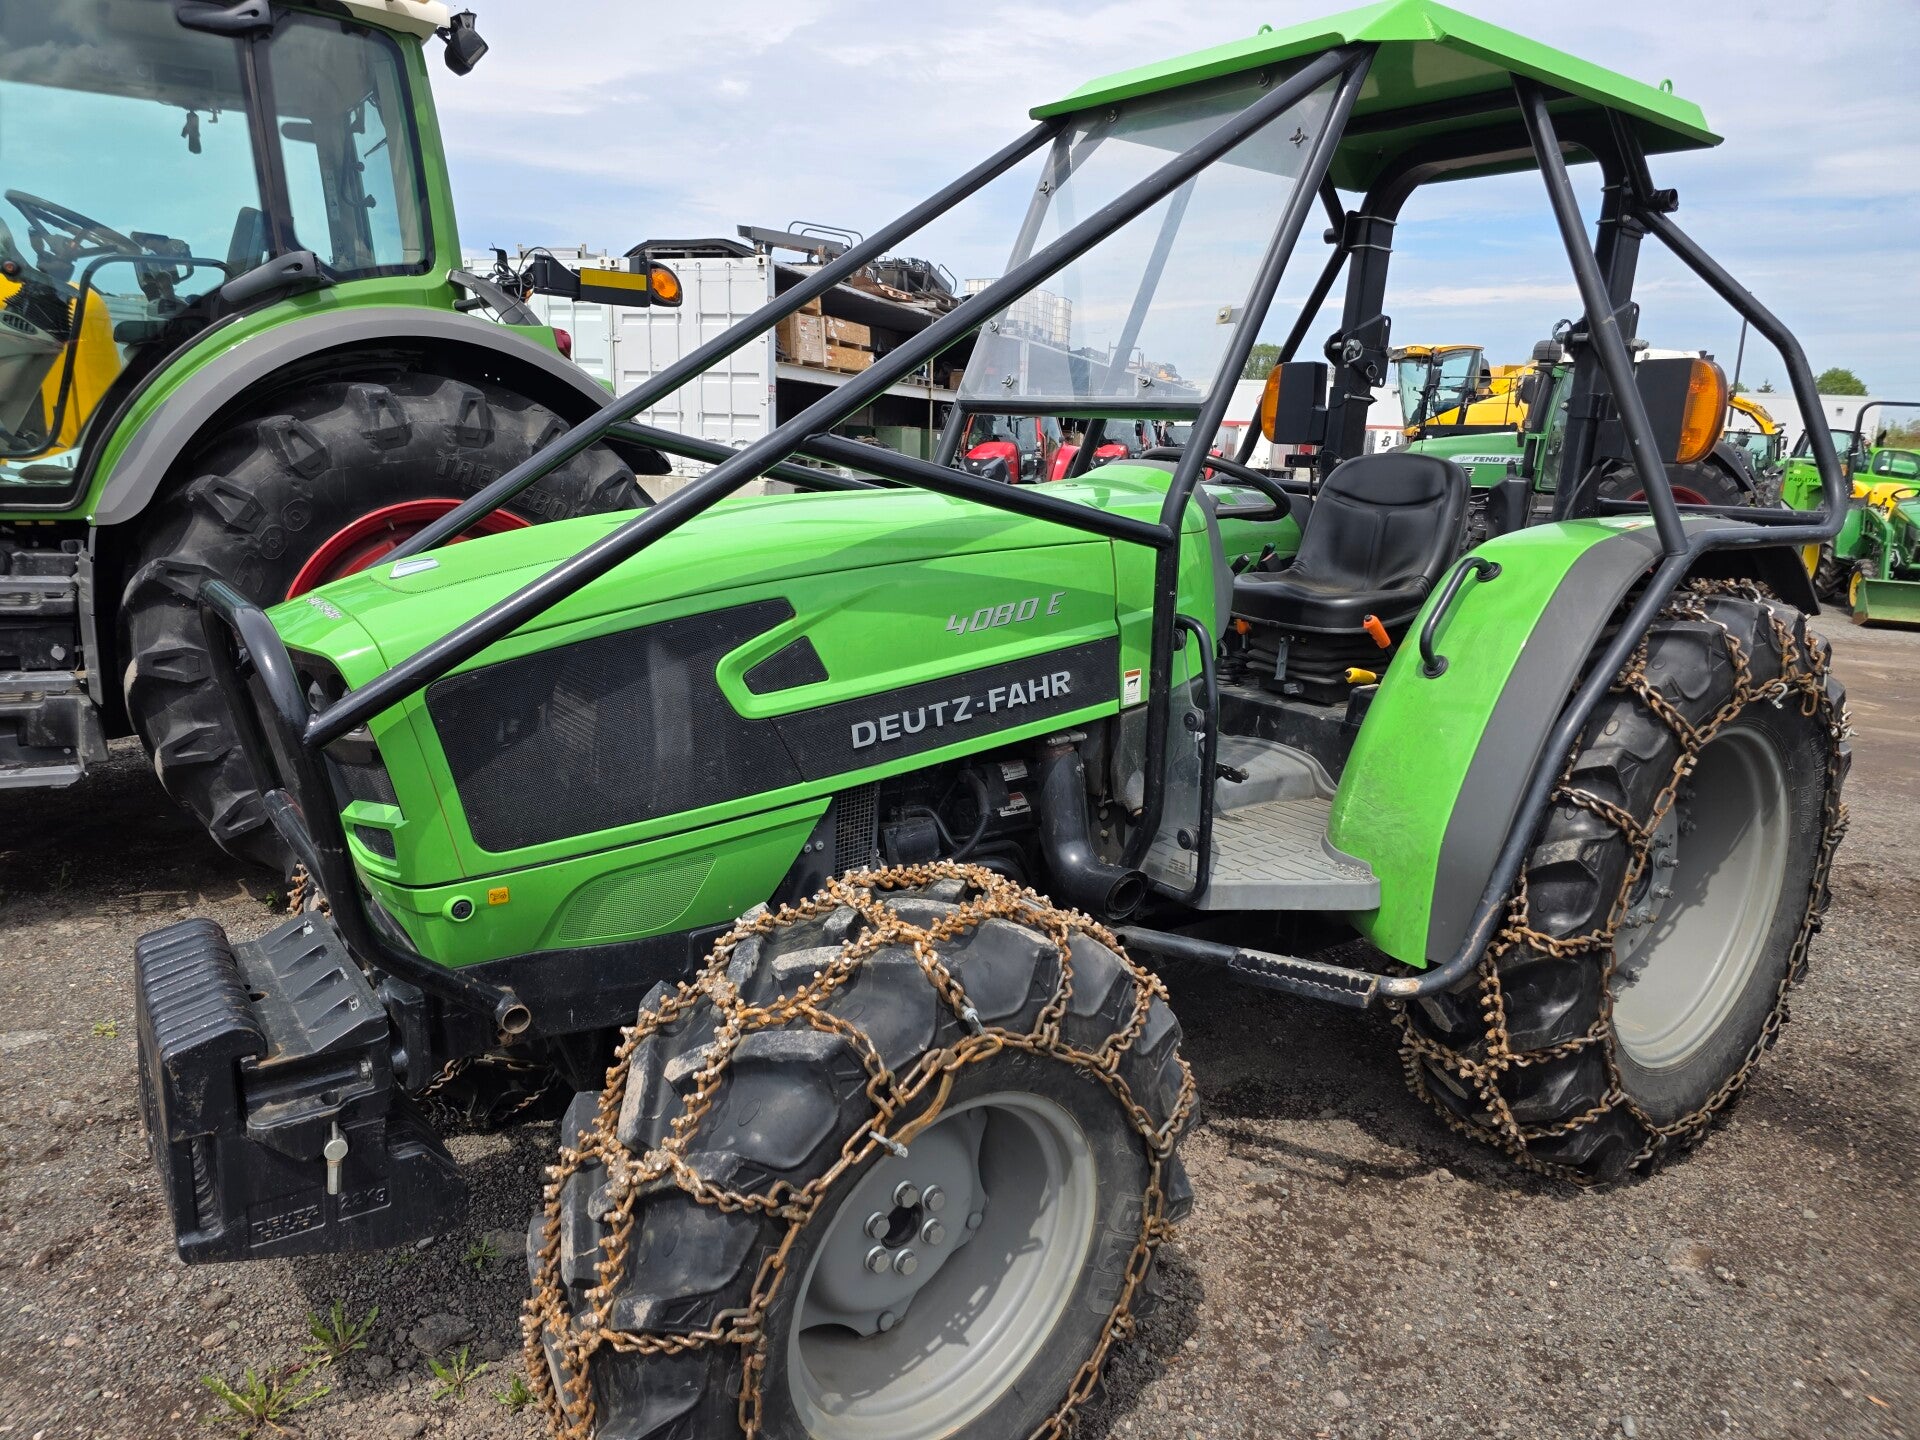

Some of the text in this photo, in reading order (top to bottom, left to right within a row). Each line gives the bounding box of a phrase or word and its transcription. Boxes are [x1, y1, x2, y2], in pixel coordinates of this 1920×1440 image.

[945, 591, 1066, 635] 4080 E
[851, 671, 1071, 749] DEUTZ-FAHR
